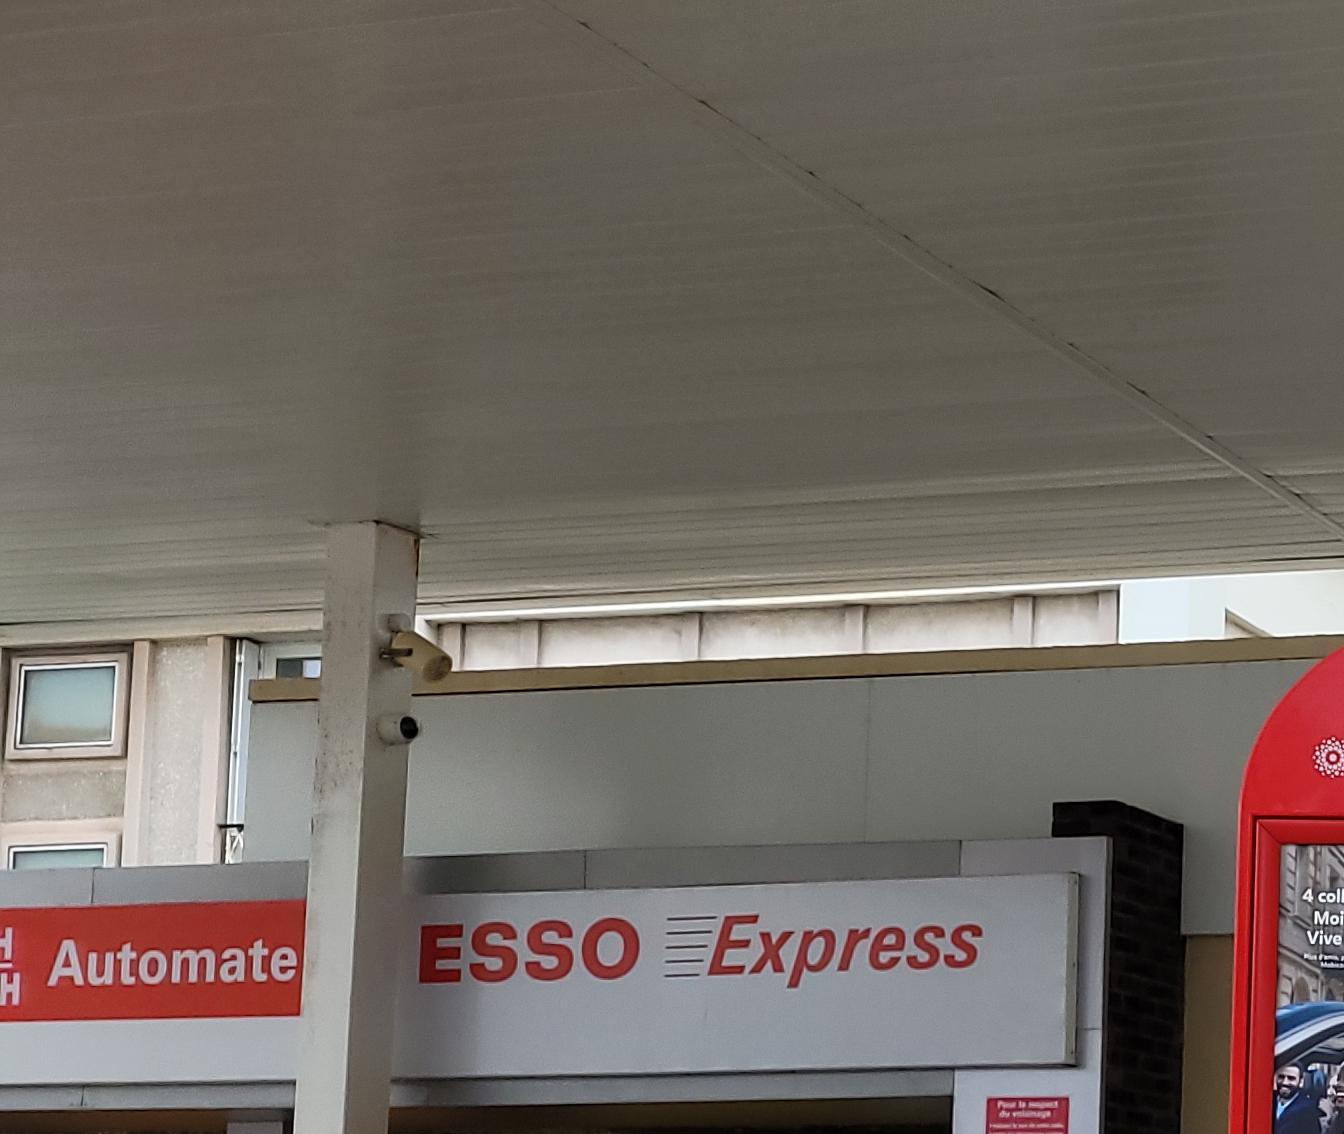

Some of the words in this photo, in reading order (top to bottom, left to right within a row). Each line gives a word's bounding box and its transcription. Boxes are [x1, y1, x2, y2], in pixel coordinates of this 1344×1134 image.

[1302, 888, 1313, 902] 4
[419, 917, 641, 984] ESSO
[707, 913, 984, 989] Express
[1306, 930, 1343, 945] Vive
[47, 938, 298, 987] Automate
